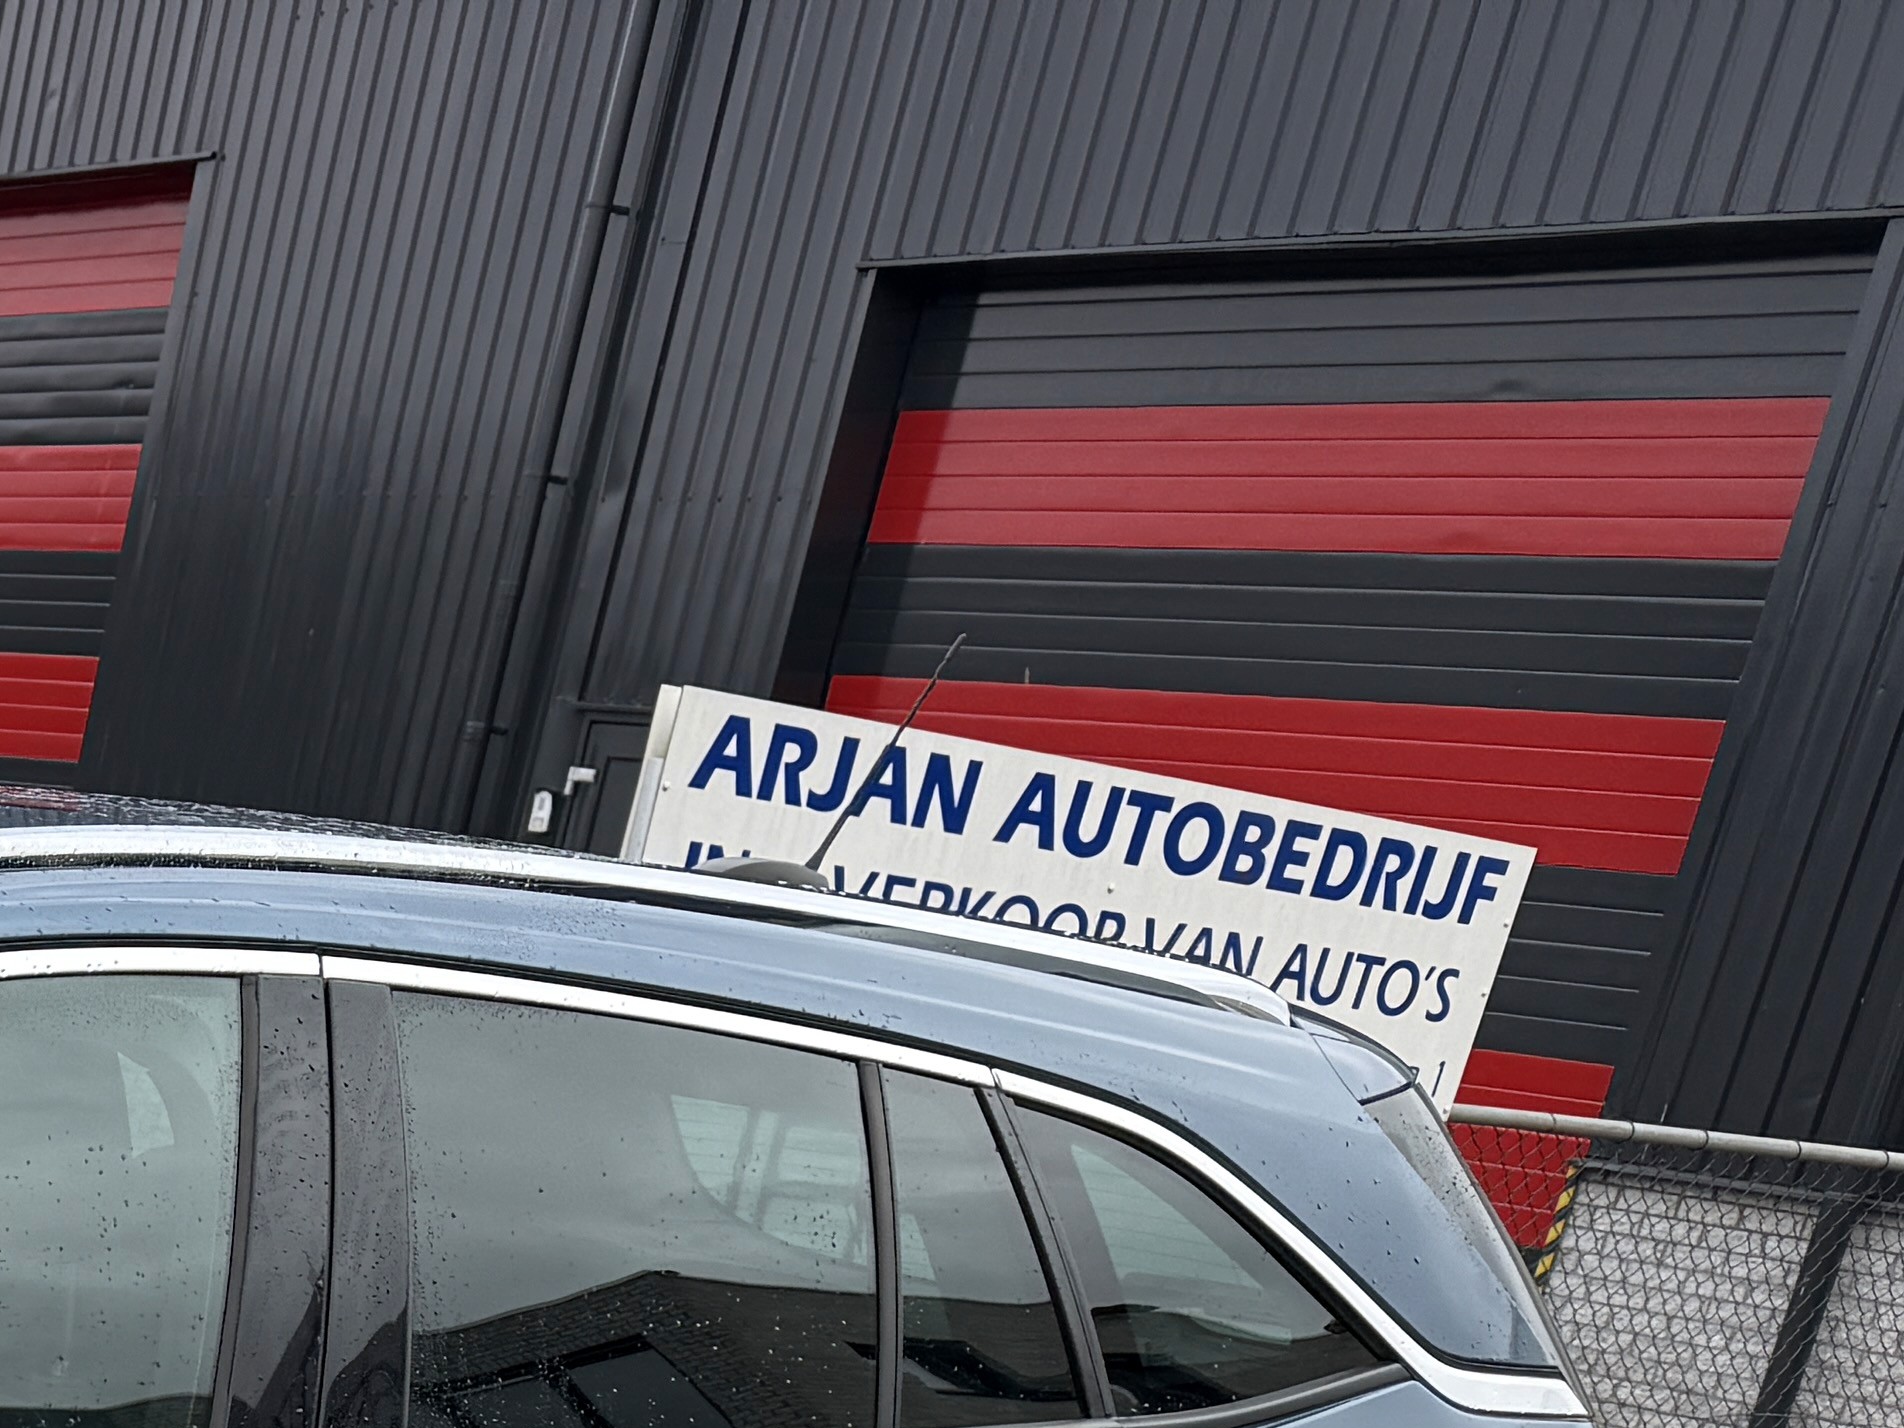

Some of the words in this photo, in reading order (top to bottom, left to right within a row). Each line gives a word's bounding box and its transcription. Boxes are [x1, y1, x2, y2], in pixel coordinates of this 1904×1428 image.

[687, 714, 984, 836] ARJAN
[992, 771, 1511, 926] AUTOBEDRIJF
[1144, 917, 1264, 977] VAN
[1270, 942, 1461, 1023] AUTO'S
